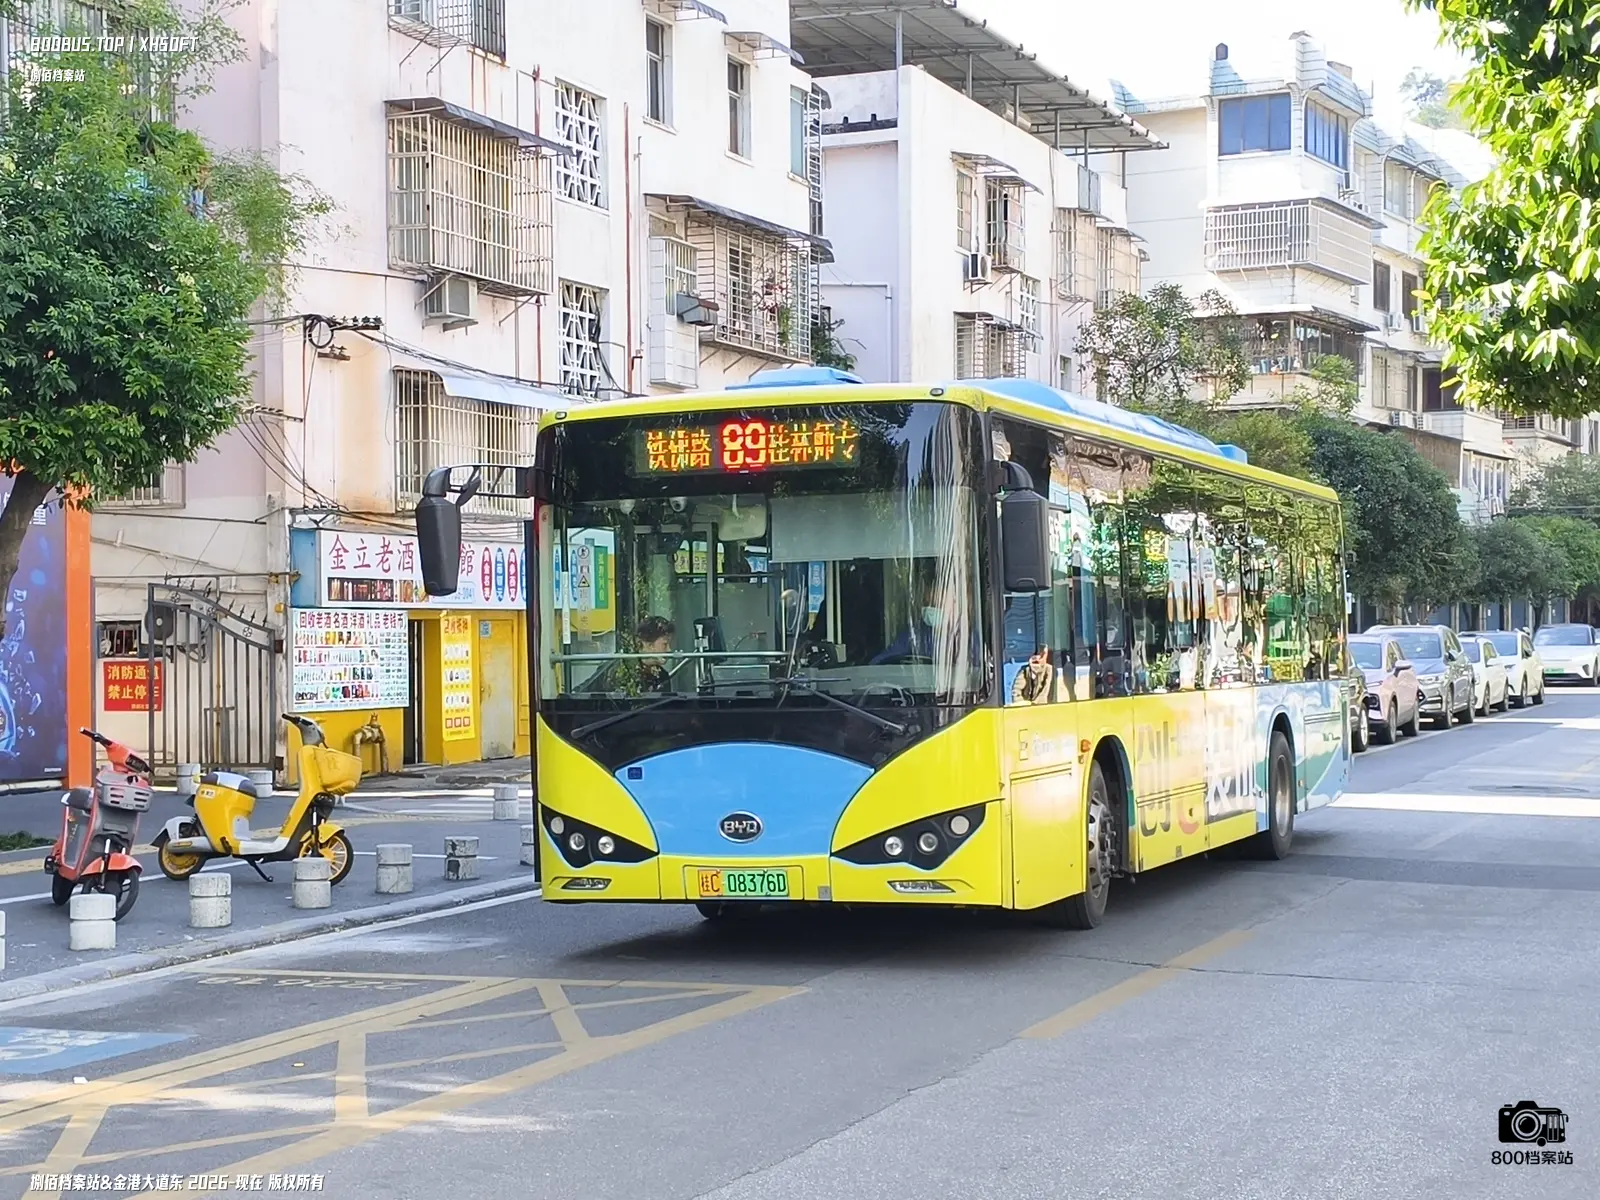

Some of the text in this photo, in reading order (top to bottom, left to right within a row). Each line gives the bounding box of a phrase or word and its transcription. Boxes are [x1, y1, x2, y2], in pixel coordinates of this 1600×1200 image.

[722, 421, 767, 469] 89
[724, 820, 758, 834] BYD
[701, 873, 787, 893] 桂C 08376D
